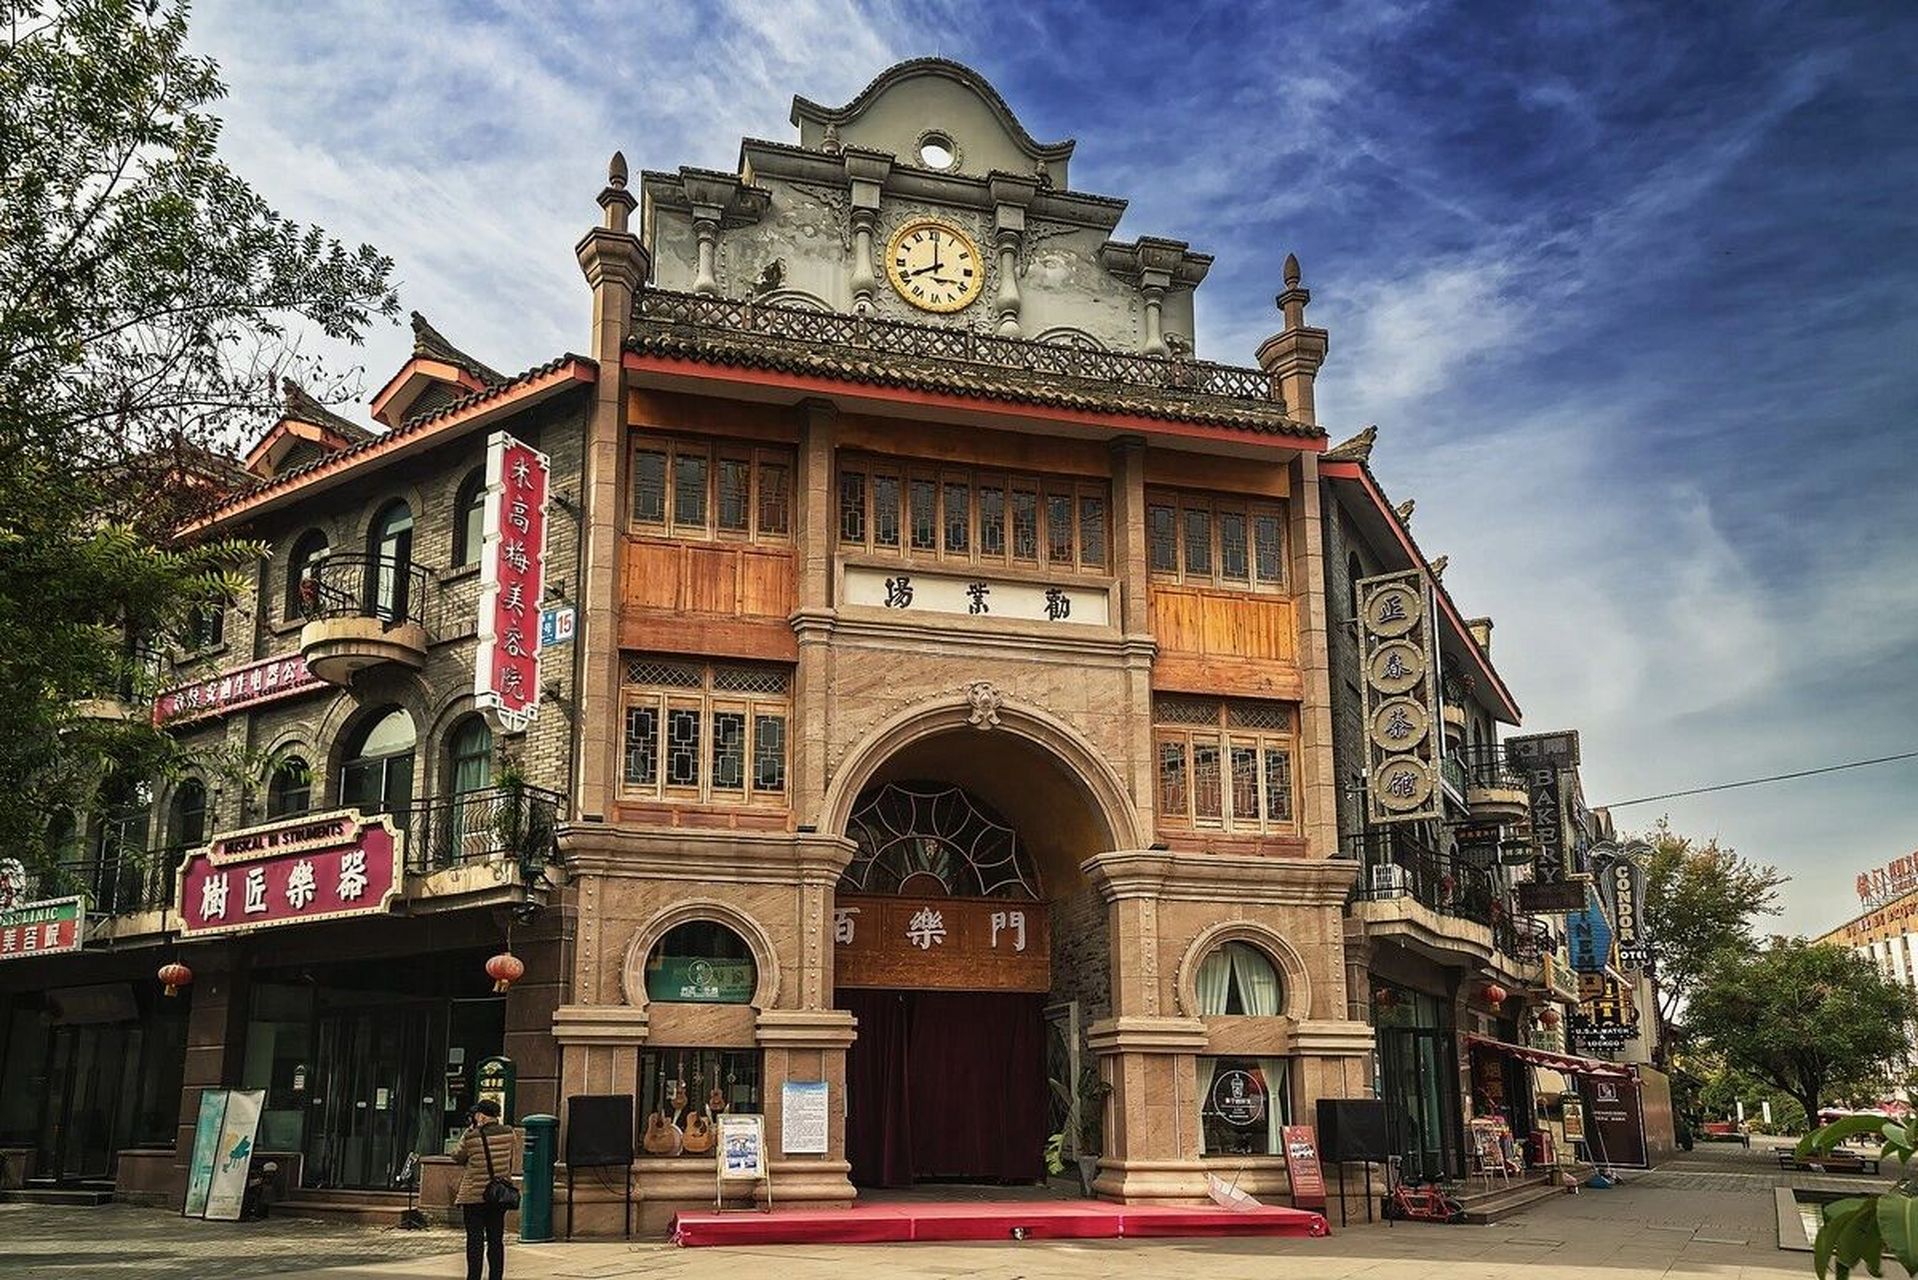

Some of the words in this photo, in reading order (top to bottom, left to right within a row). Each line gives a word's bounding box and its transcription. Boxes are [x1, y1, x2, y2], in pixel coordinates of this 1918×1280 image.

[558, 613, 572, 634] 15
[1532, 769, 1560, 884] BAKERY
[200, 850, 368, 922] 樹匠樂器
[1616, 866, 1634, 941] CONDOR
[834, 906, 1026, 952] 百樂門
